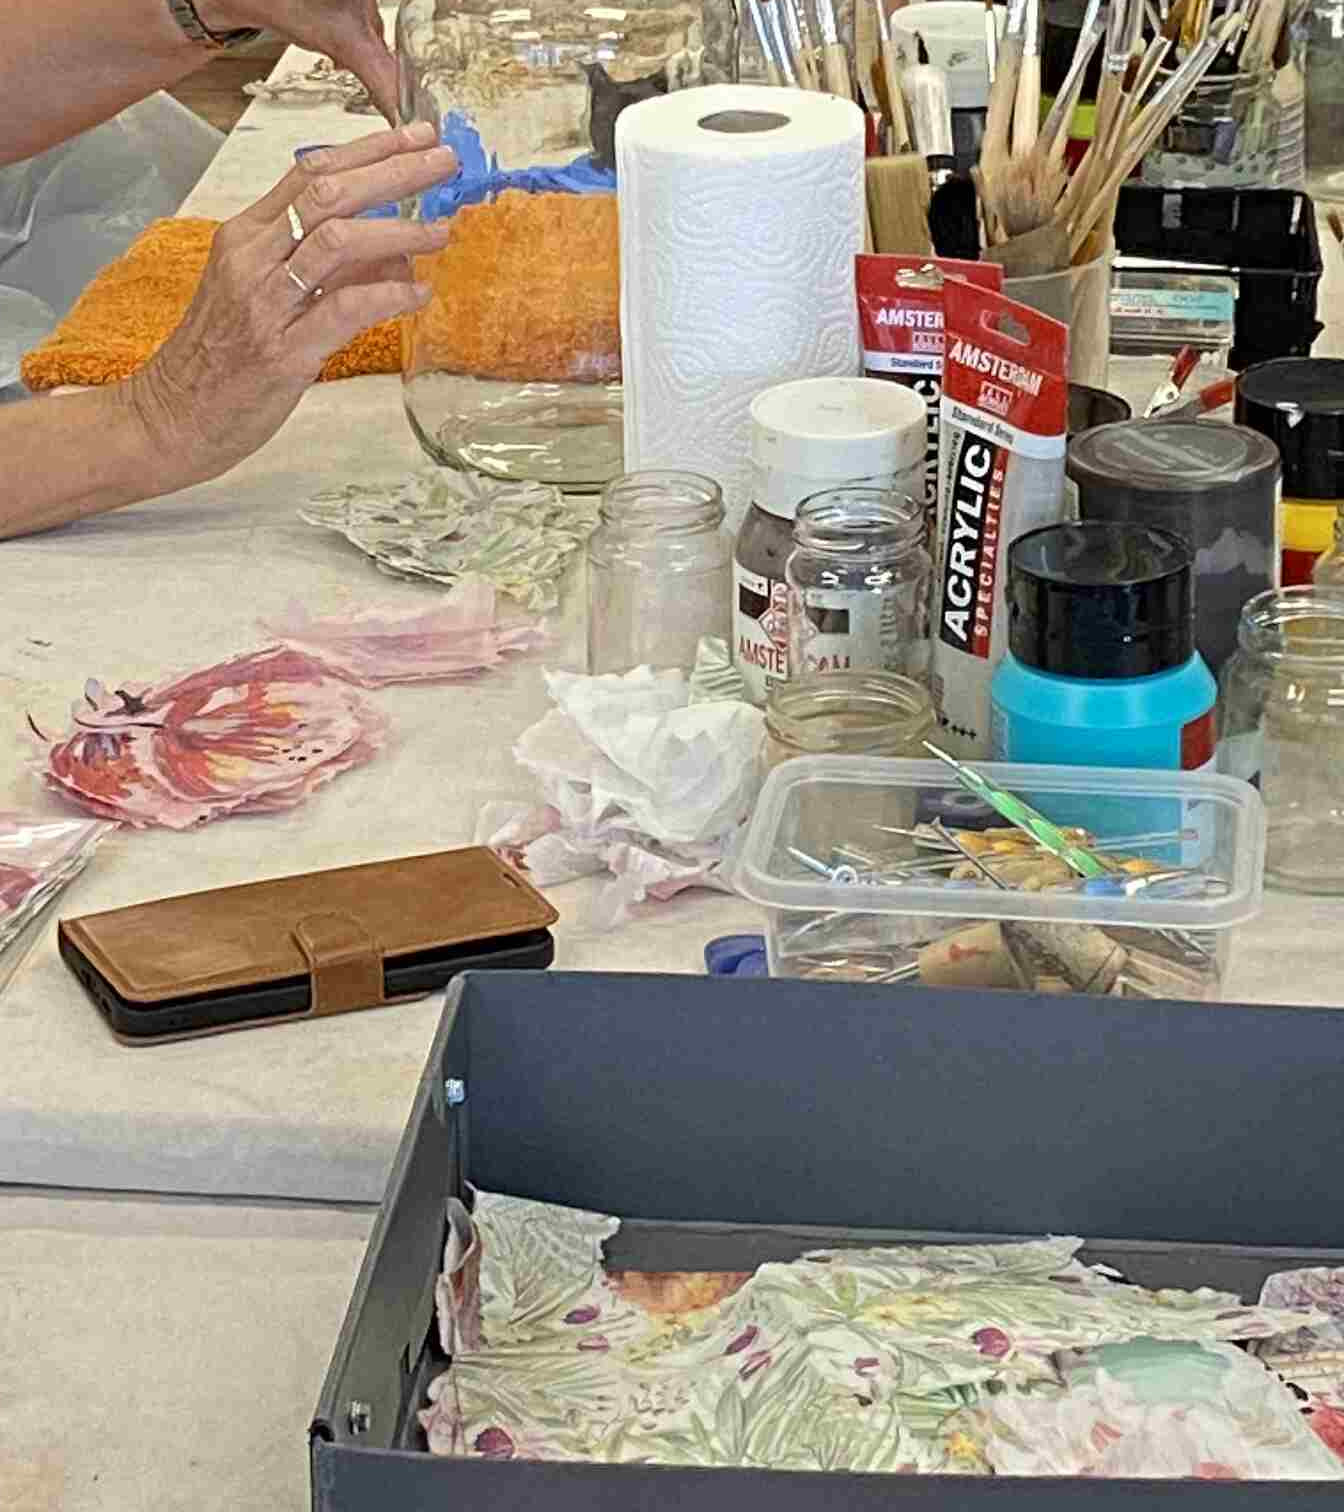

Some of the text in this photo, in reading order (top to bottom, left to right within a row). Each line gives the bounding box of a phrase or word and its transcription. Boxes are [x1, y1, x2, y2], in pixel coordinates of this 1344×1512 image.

[876, 308, 944, 328] AMSTER
[947, 337, 1044, 396] AMSTERDAM
[945, 442, 992, 642] ACRYLIC
[973, 468, 1004, 638] SPECIALTIES
